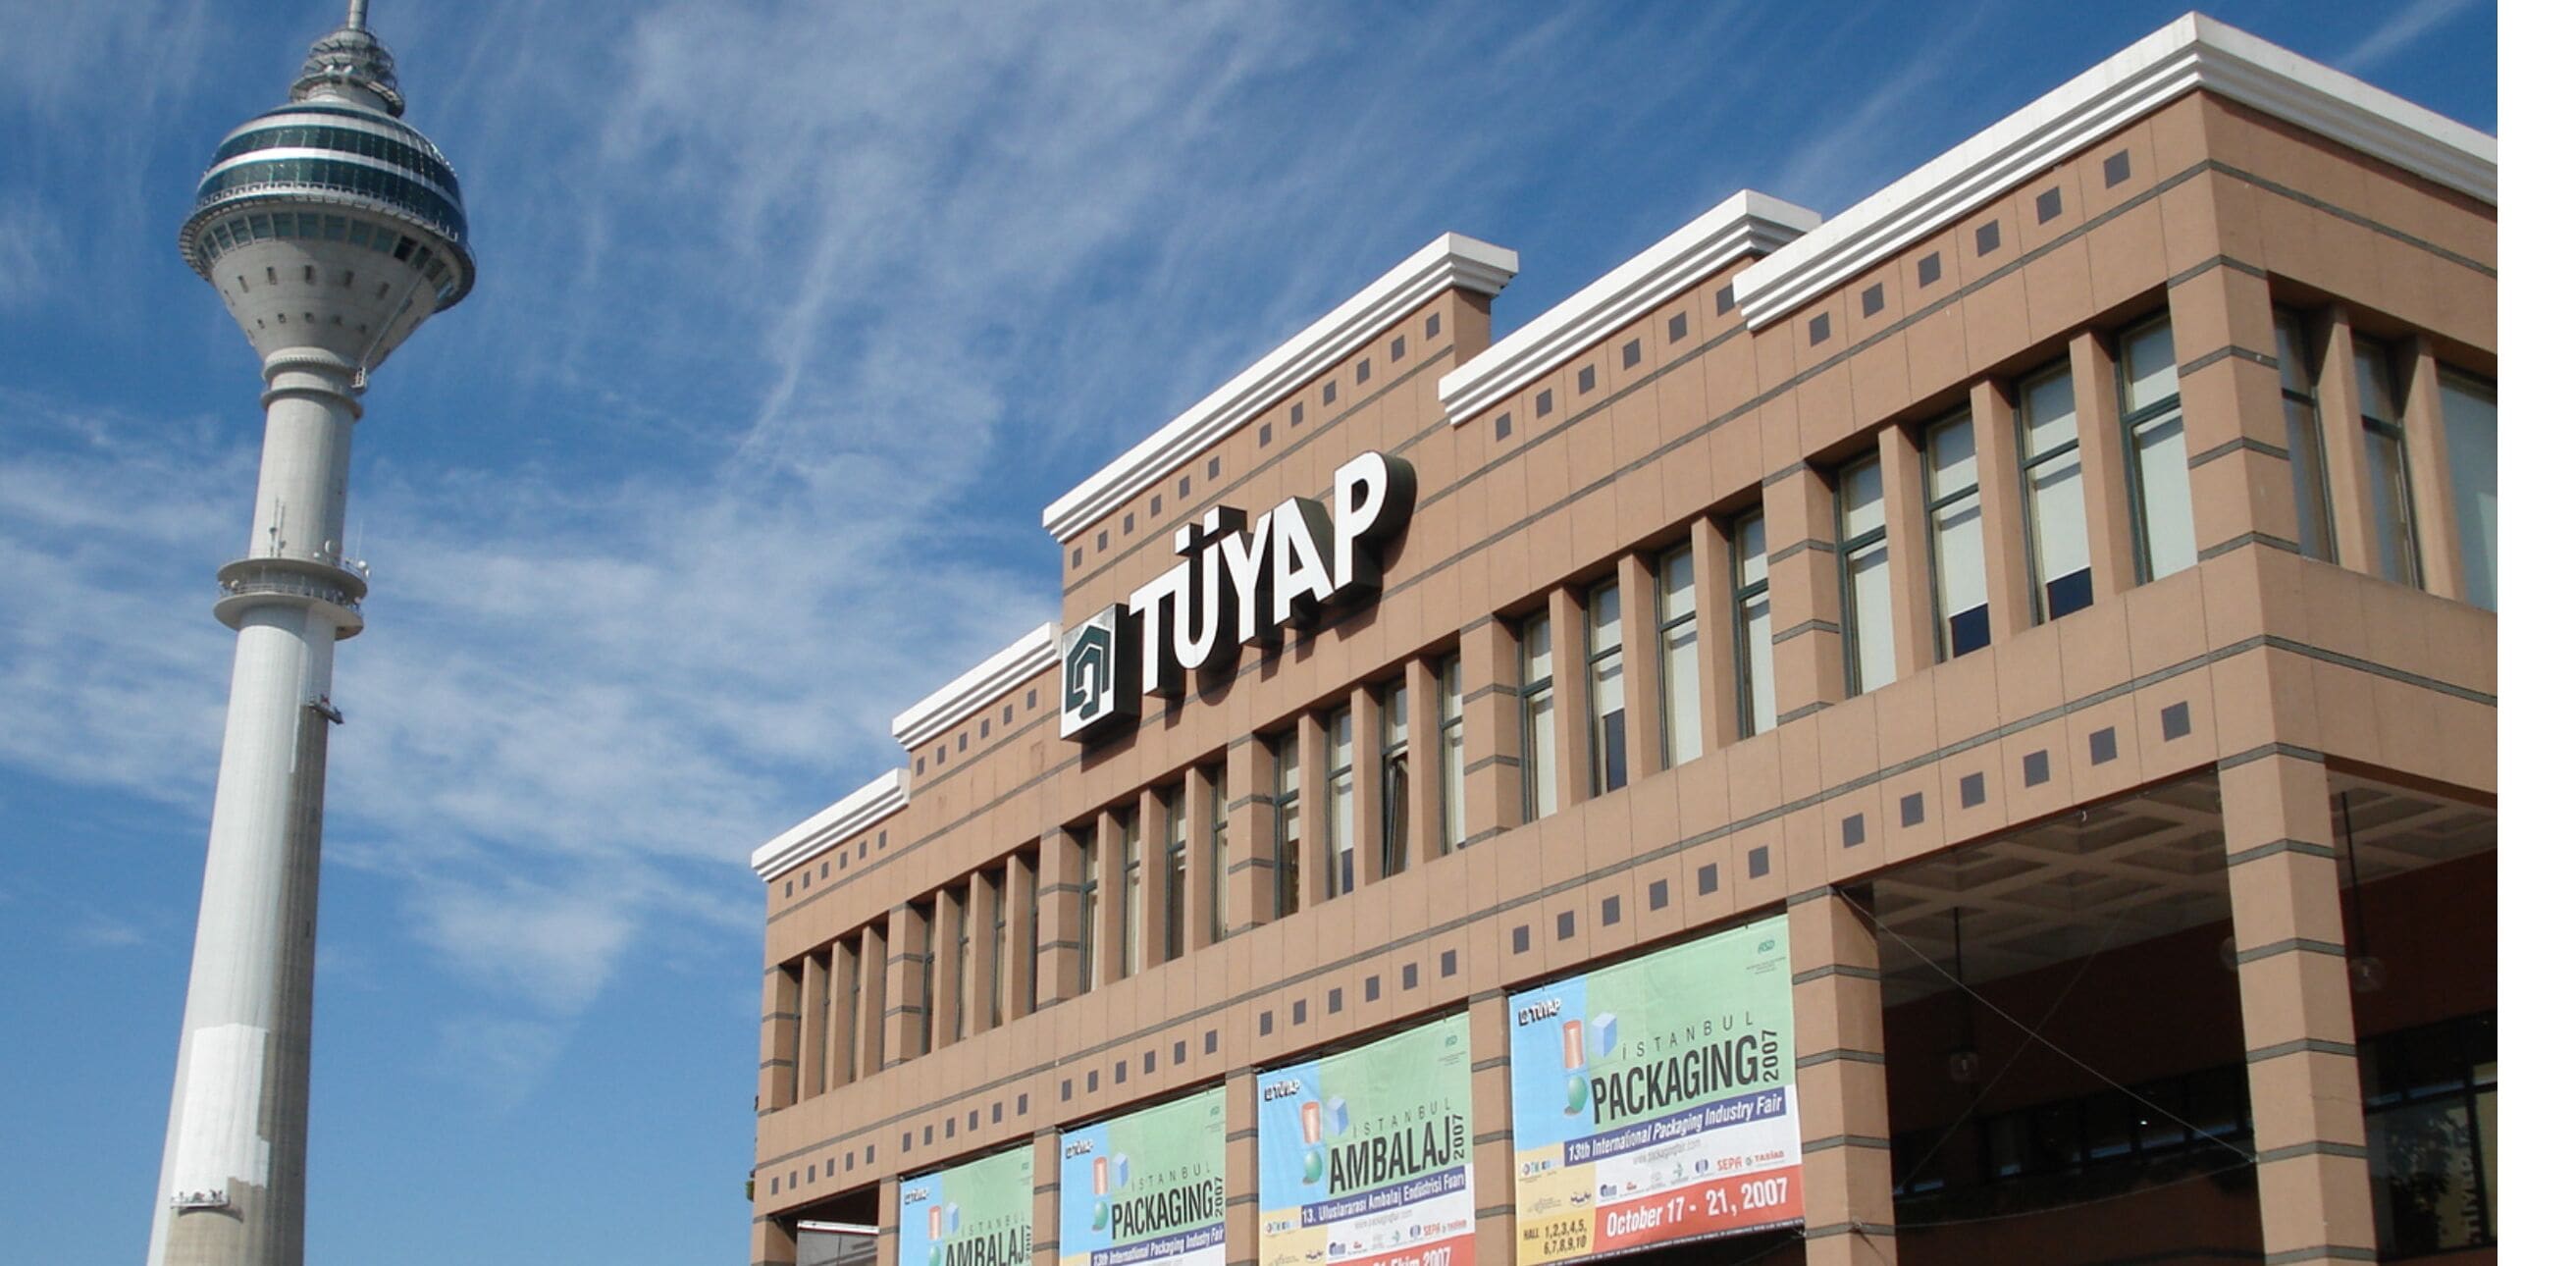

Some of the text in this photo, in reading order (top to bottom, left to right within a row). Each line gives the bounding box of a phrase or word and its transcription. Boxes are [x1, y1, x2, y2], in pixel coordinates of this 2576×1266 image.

[1129, 450, 1392, 696] TÜYAP
[1591, 1034, 1759, 1125] PACKAGING
[1761, 1029, 1779, 1082] 2007
[1329, 1115, 1451, 1194] AMBALAJ
[1452, 1113, 1465, 1161] 2007
[1569, 1092, 1782, 1162] 13th International Packaging Industry Fair
[1111, 1180, 1214, 1240] PACKAGING
[1214, 1176, 1224, 1218] 2007
[1302, 1208, 1316, 1225] 13.
[1318, 1199, 1367, 1221] Uluslararası
[1368, 1187, 1403, 1210] Ambalaj
[1403, 1178, 1443, 1201] Endüstrisi
[1606, 1205, 1663, 1237] October
[1667, 1195, 1685, 1224] 17
[1706, 1187, 1738, 1217] 21,
[1741, 1177, 1788, 1210] 2007
[945, 1225, 1025, 1266] AMBALAJ
